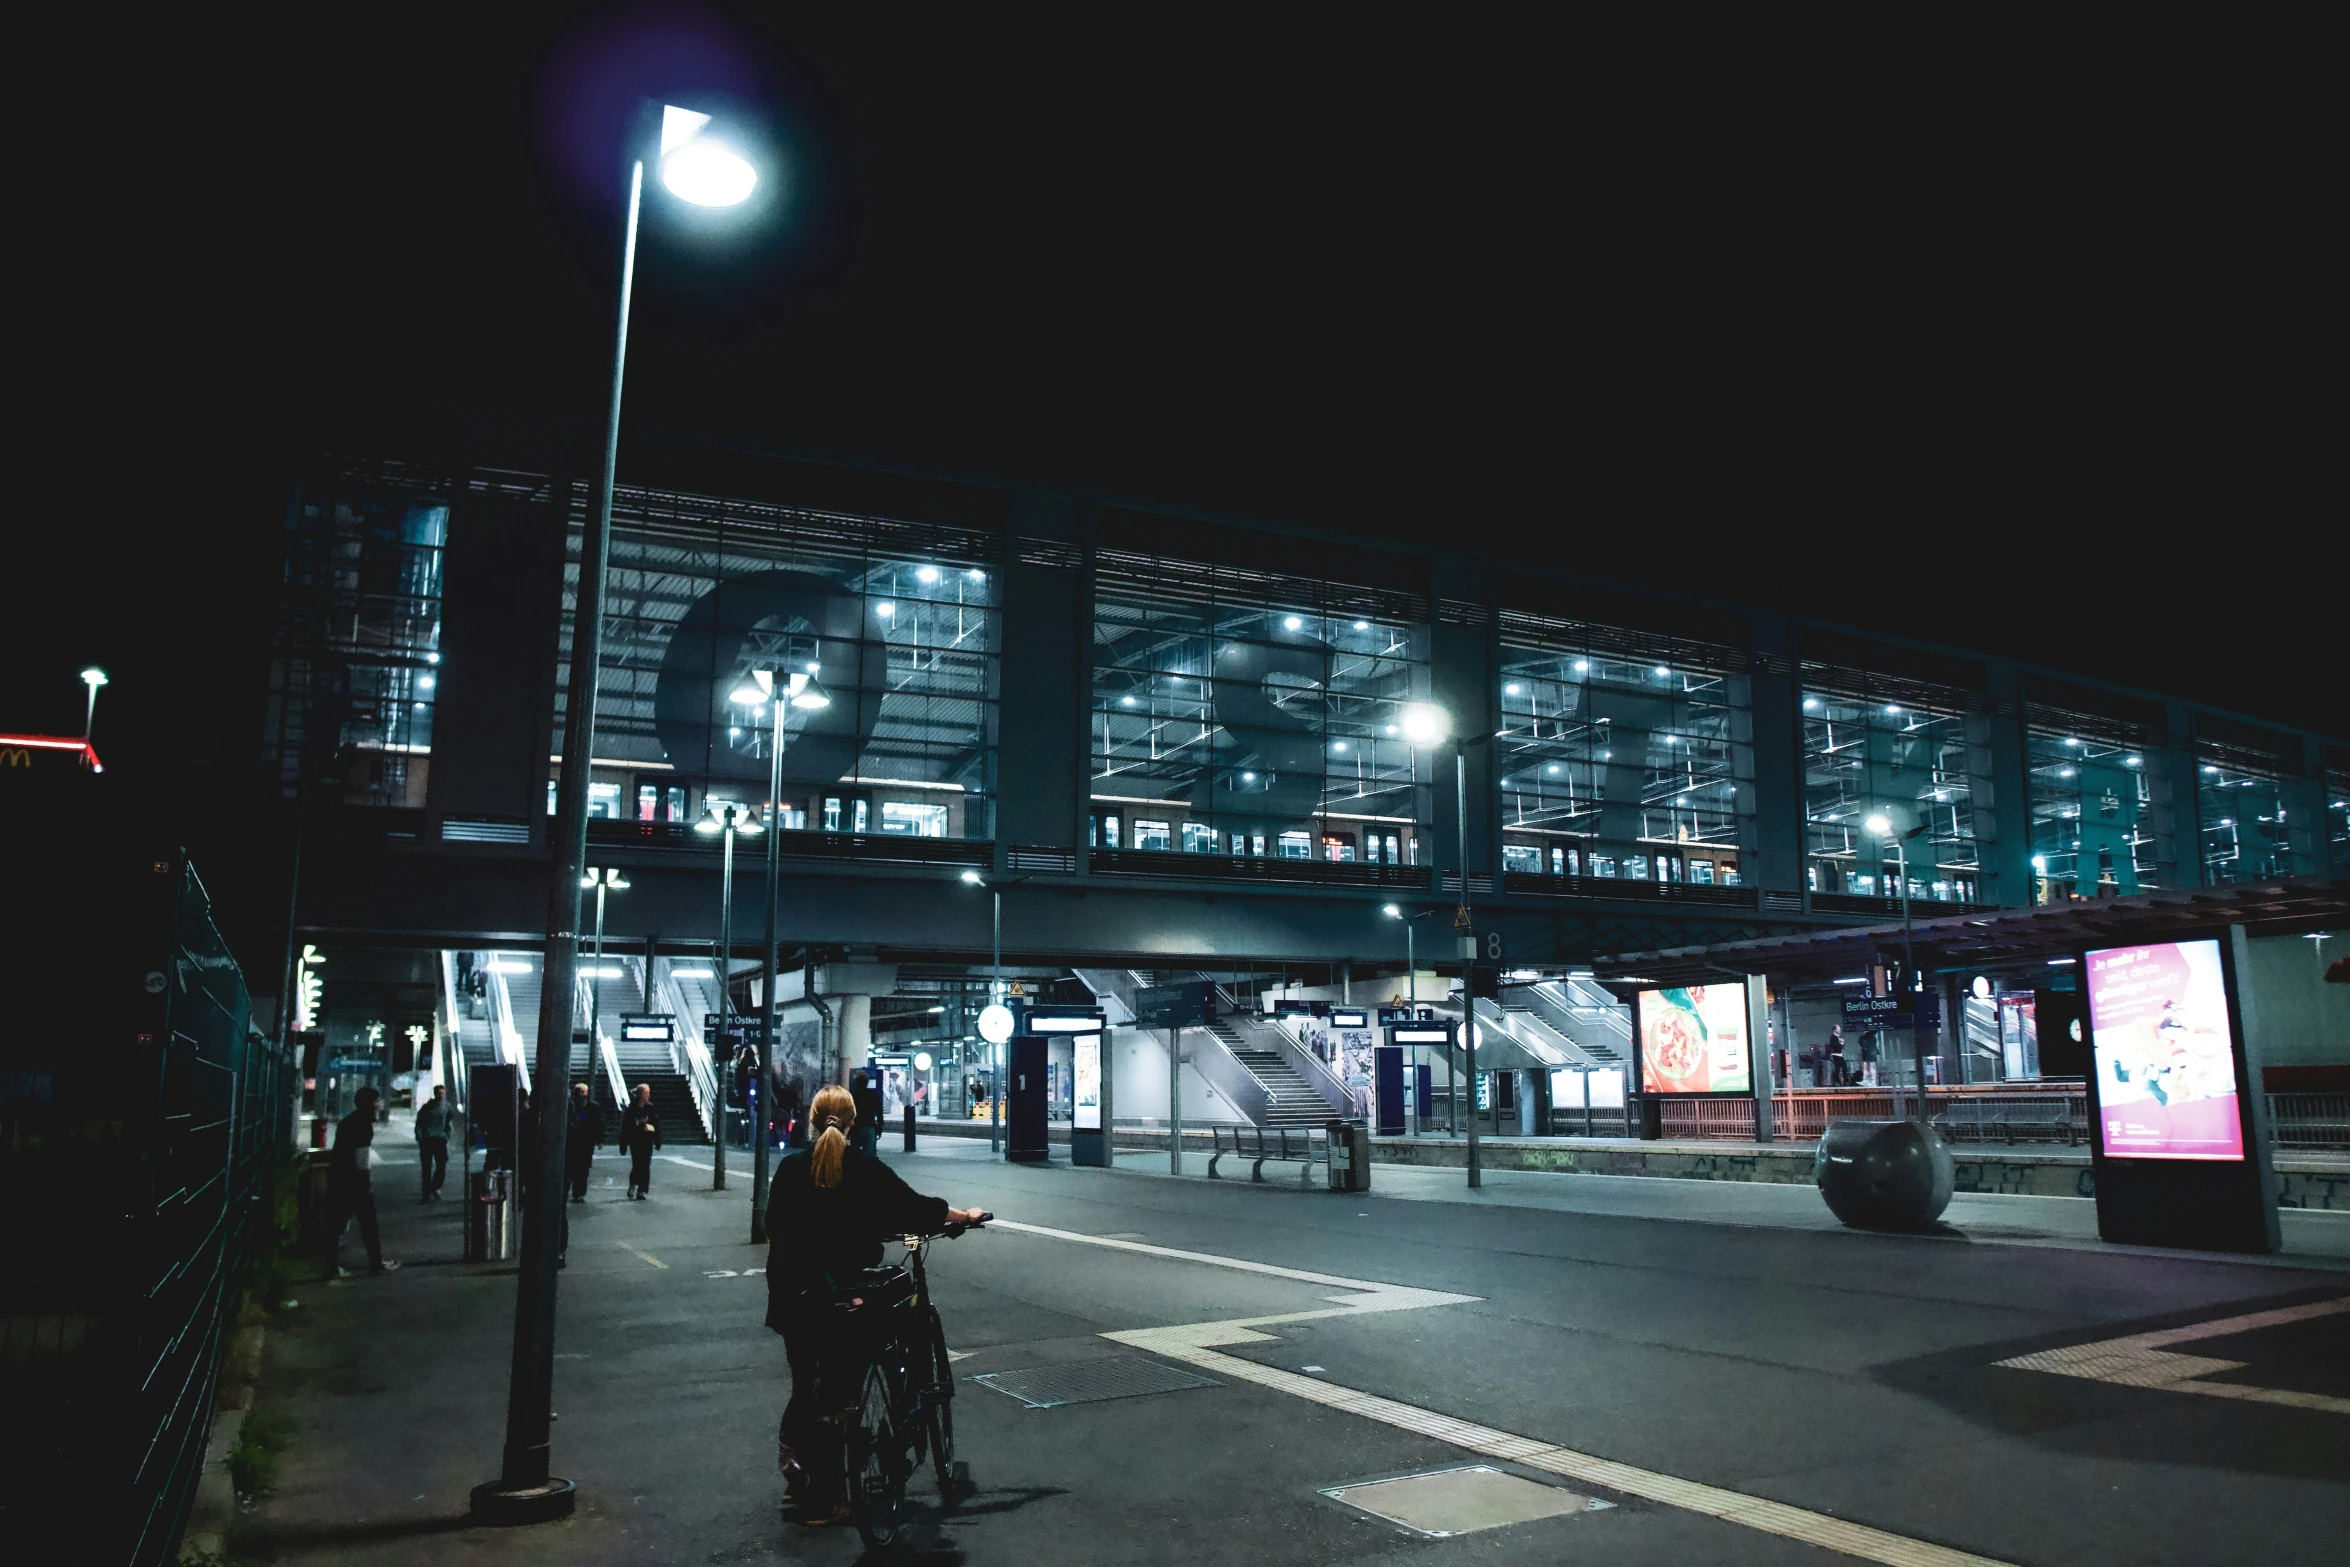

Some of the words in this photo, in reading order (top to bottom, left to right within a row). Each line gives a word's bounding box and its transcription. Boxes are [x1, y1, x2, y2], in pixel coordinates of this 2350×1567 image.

[1487, 932, 1502, 960] 8
[1846, 1001, 1869, 1012] Berlin
[1871, 1000, 1898, 1010] Ostkre
[735, 1016, 762, 1025] Ostkre
